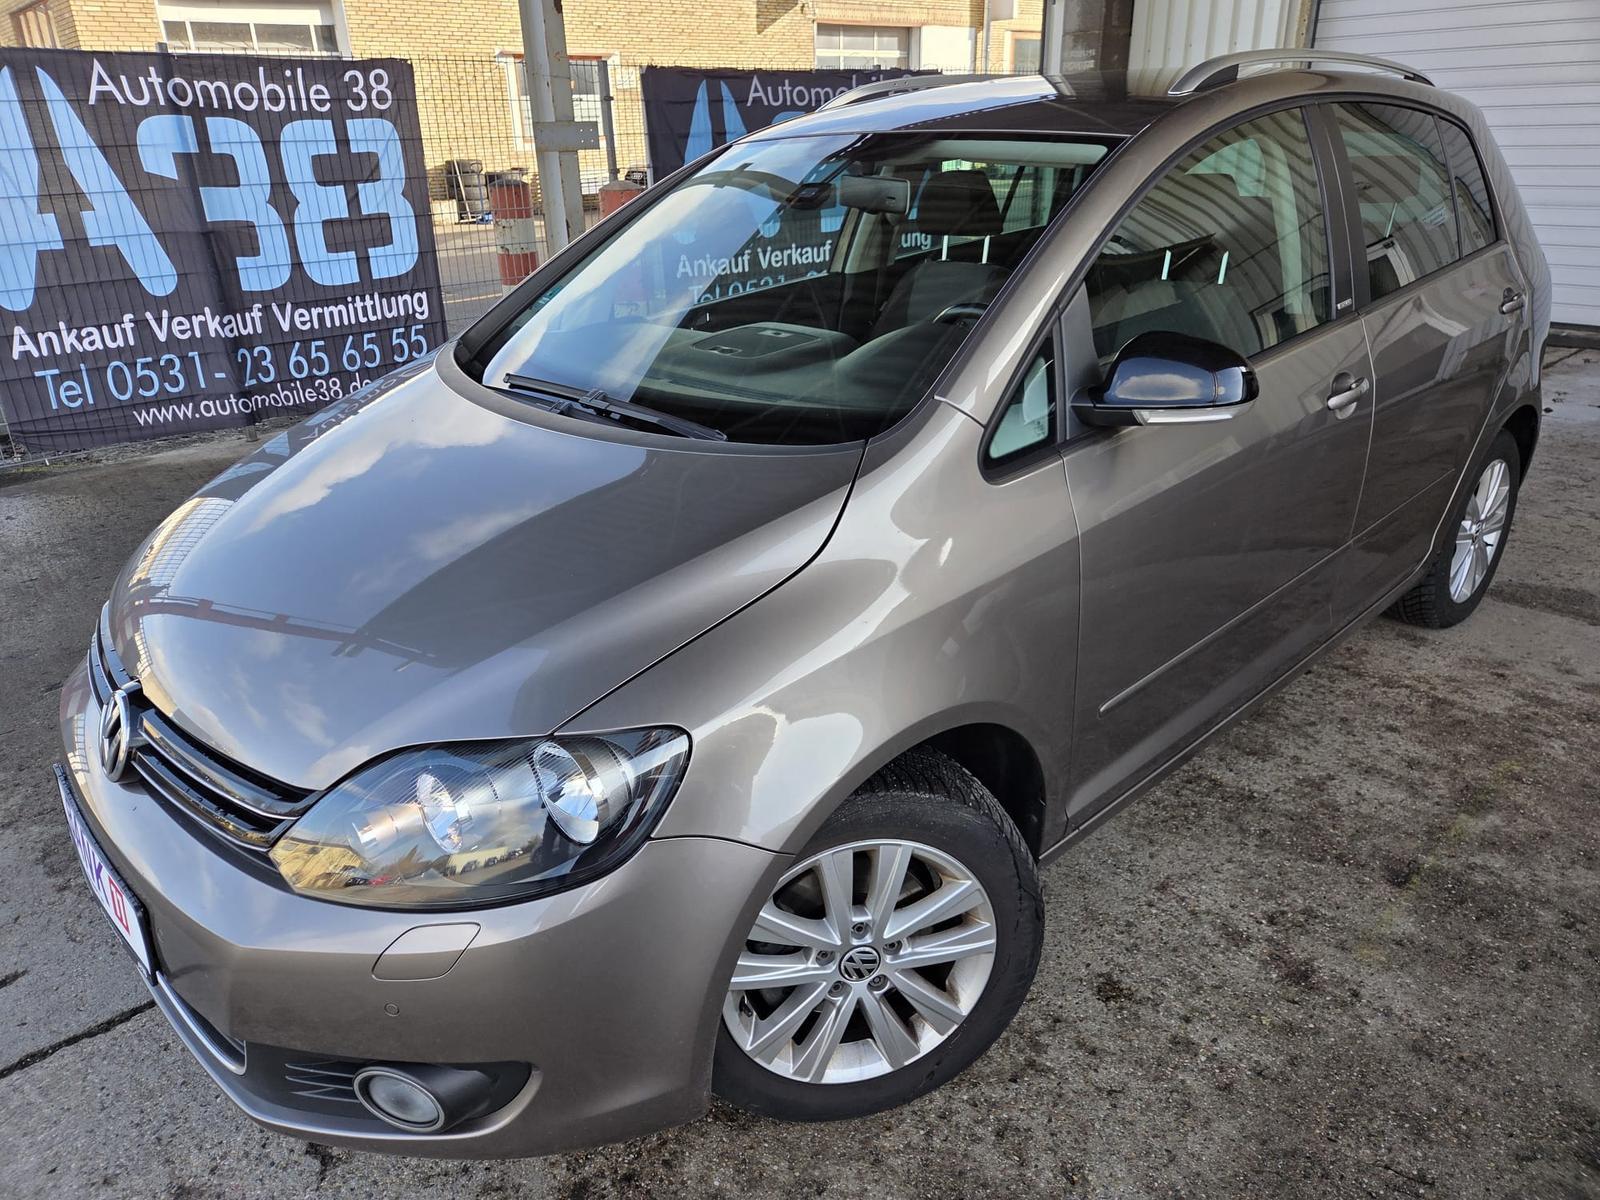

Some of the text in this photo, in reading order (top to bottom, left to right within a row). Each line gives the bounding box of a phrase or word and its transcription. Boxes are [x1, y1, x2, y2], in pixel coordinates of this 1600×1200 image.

[88, 58, 393, 112] Automobile 38
[676, 248, 751, 279] Ankauf
[756, 239, 833, 269] Verkauf
[11, 290, 429, 361] Ankauf Verkauf Vermittlung
[34, 363, 96, 410] Tel
[237, 345, 276, 387] 23
[288, 340, 331, 379] 65
[342, 332, 381, 372] 65
[391, 324, 429, 363] 55
